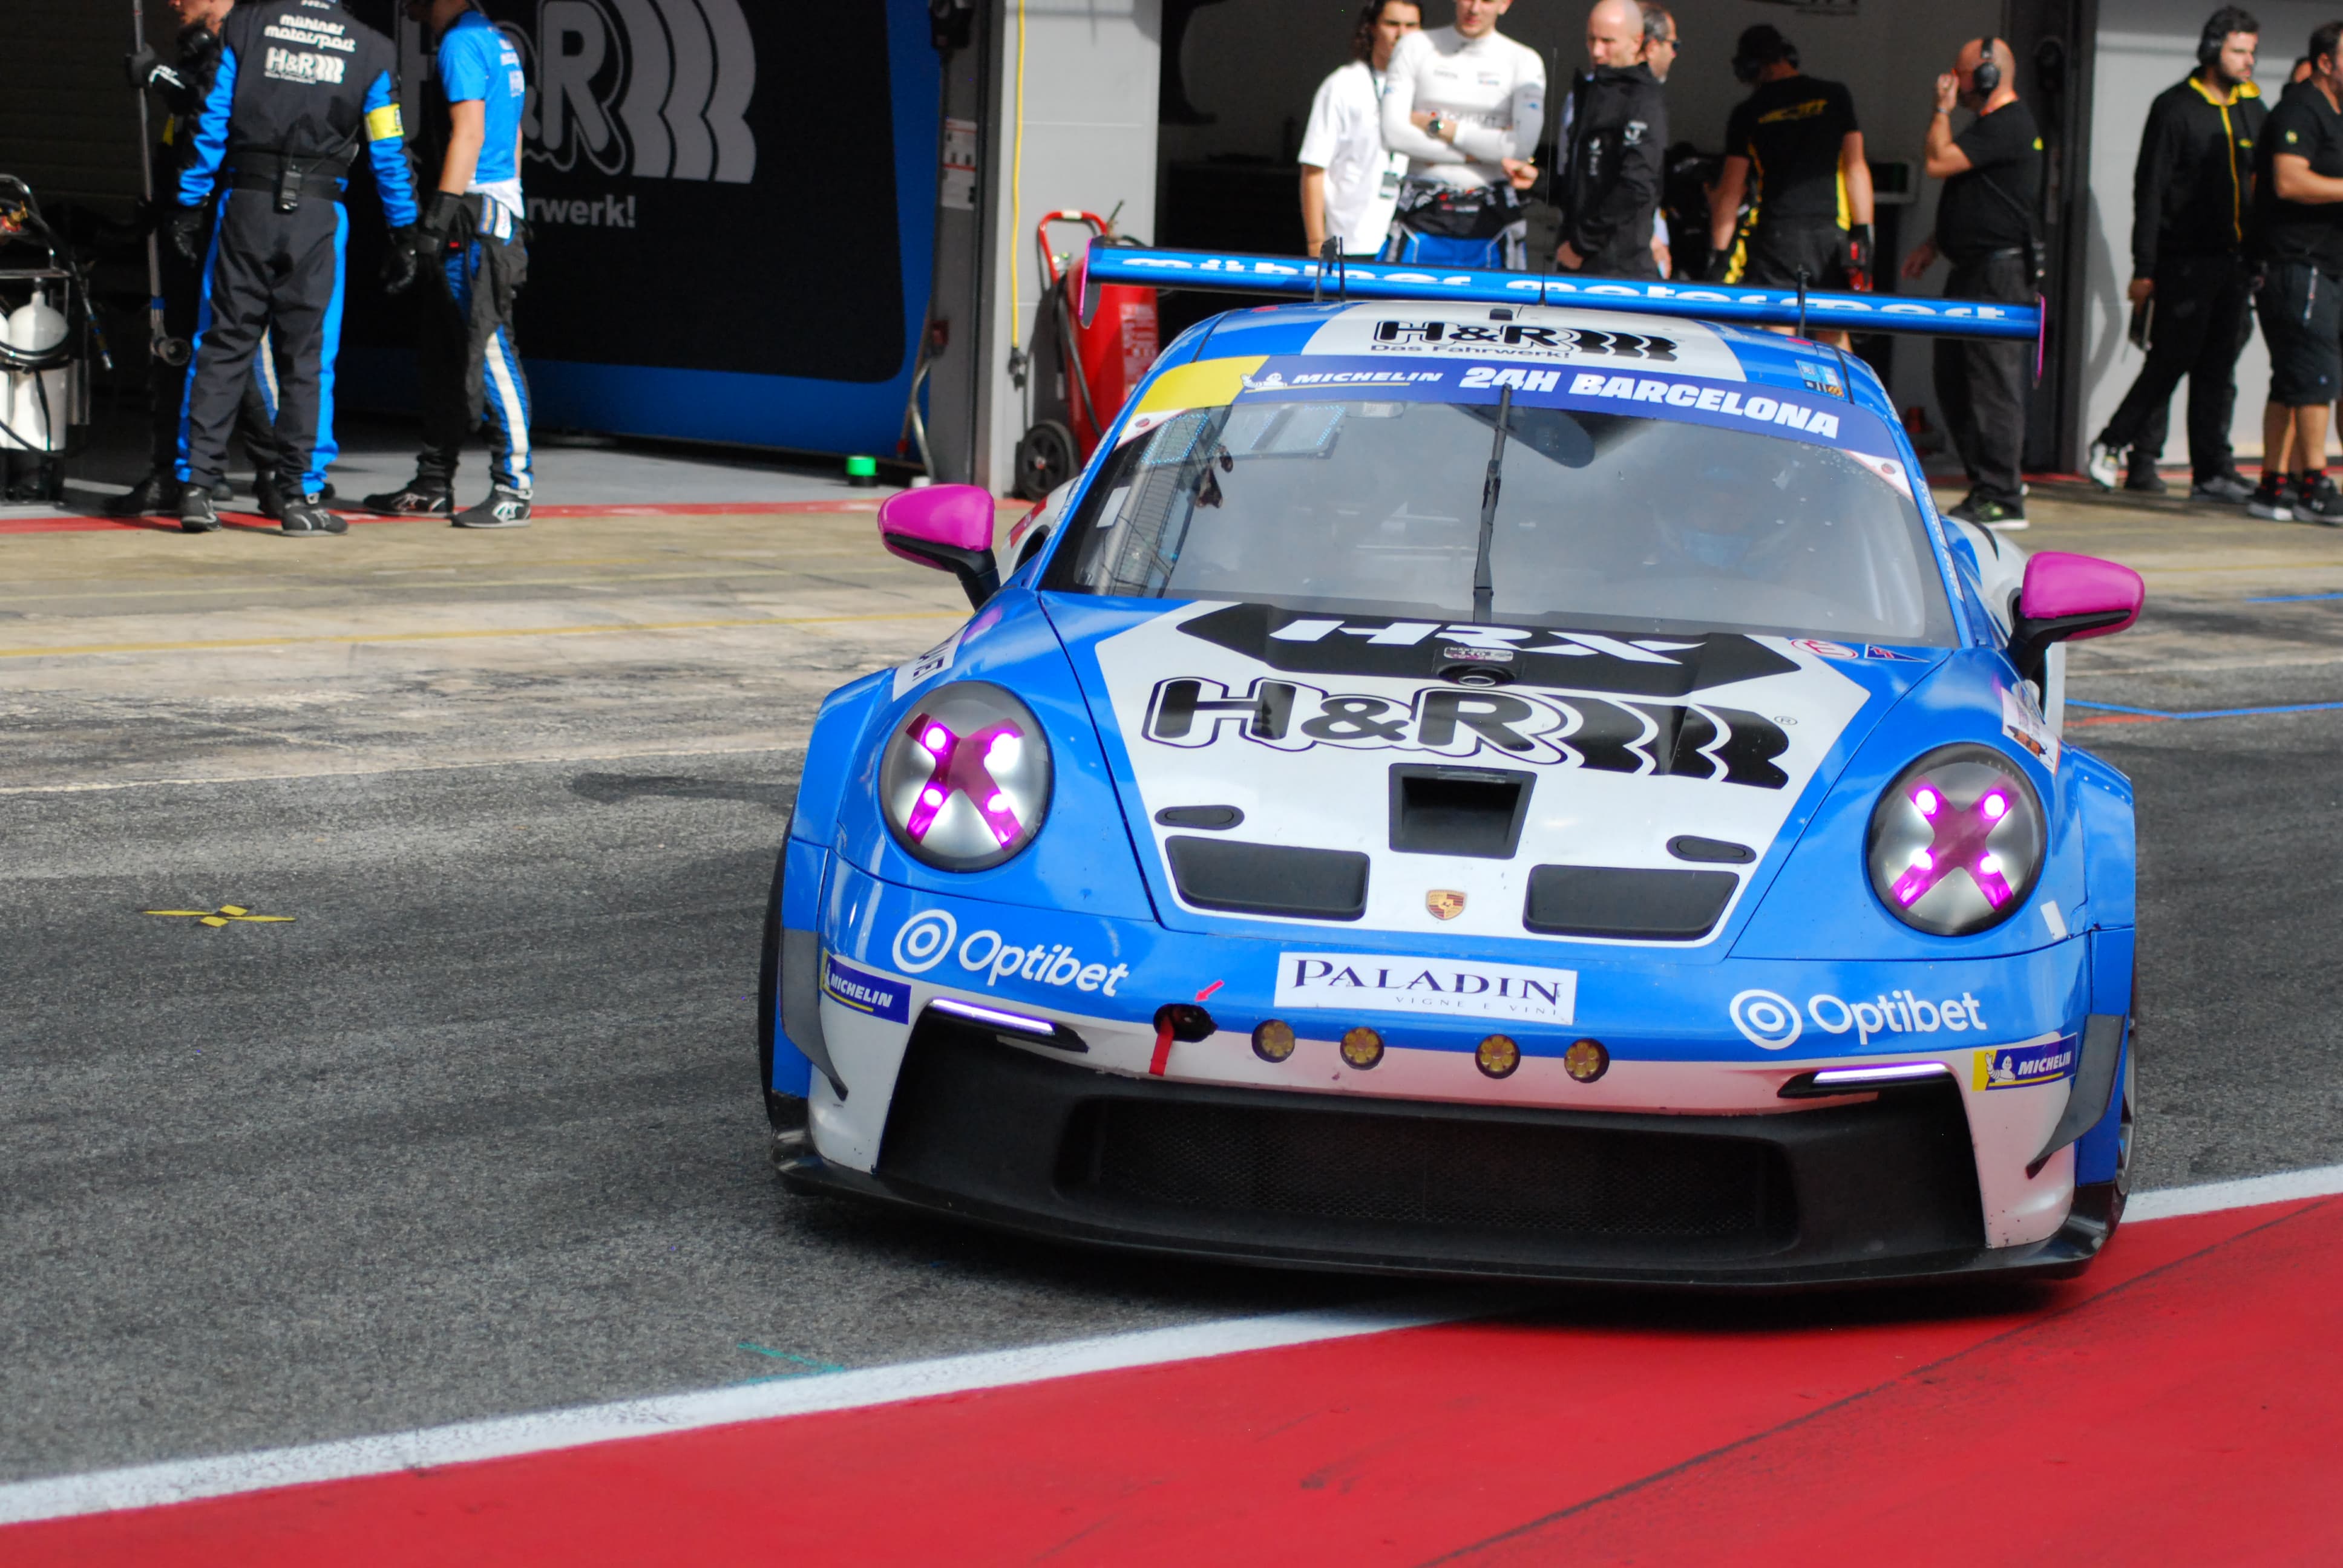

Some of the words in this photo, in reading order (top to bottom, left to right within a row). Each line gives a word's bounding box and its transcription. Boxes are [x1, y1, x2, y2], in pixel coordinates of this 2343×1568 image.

[264, 25, 356, 53] motorsport
[266, 47, 317, 77] H&R
[526, 192, 636, 229] rwerk!
[1374, 321, 1575, 353] H&R
[1432, 345, 1570, 359] Fahrwerk!
[1292, 372, 1443, 384] MICHELIN
[1458, 366, 1561, 393] 24H
[1568, 372, 1839, 439] BARCELONA
[1142, 676, 1570, 766] H&R
[959, 929, 1130, 997] Optibet
[830, 973, 893, 1008] MICHELIN
[1293, 958, 1564, 1007] PALADIN
[1395, 996, 1464, 1008] VIGNE
[1509, 1004, 1556, 1016] VINI
[1807, 990, 1987, 1045] Optibet
[2017, 1051, 2072, 1076] MICHELIN
